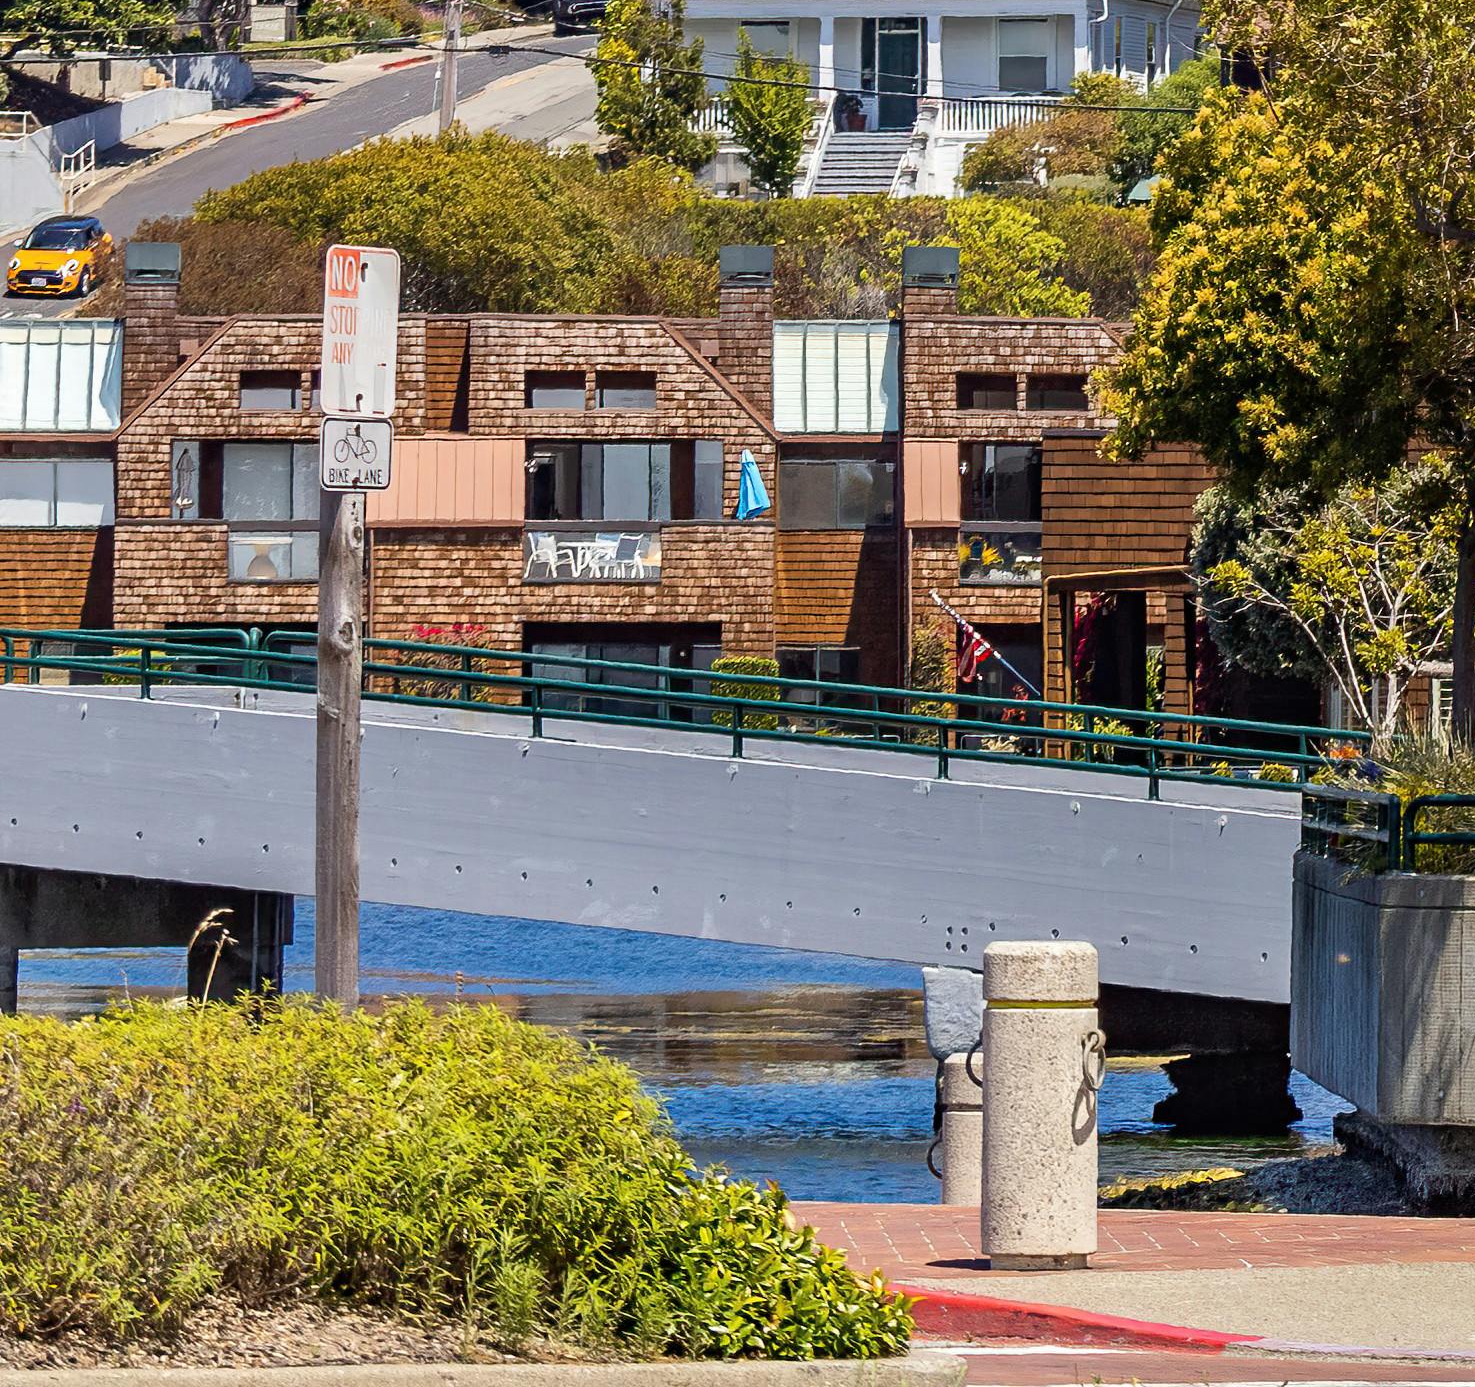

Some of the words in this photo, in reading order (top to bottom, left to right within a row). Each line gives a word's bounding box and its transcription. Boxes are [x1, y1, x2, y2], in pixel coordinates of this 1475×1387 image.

[331, 254, 357, 291] NO
[328, 468, 350, 483] BIKE
[358, 469, 383, 484] LANE
